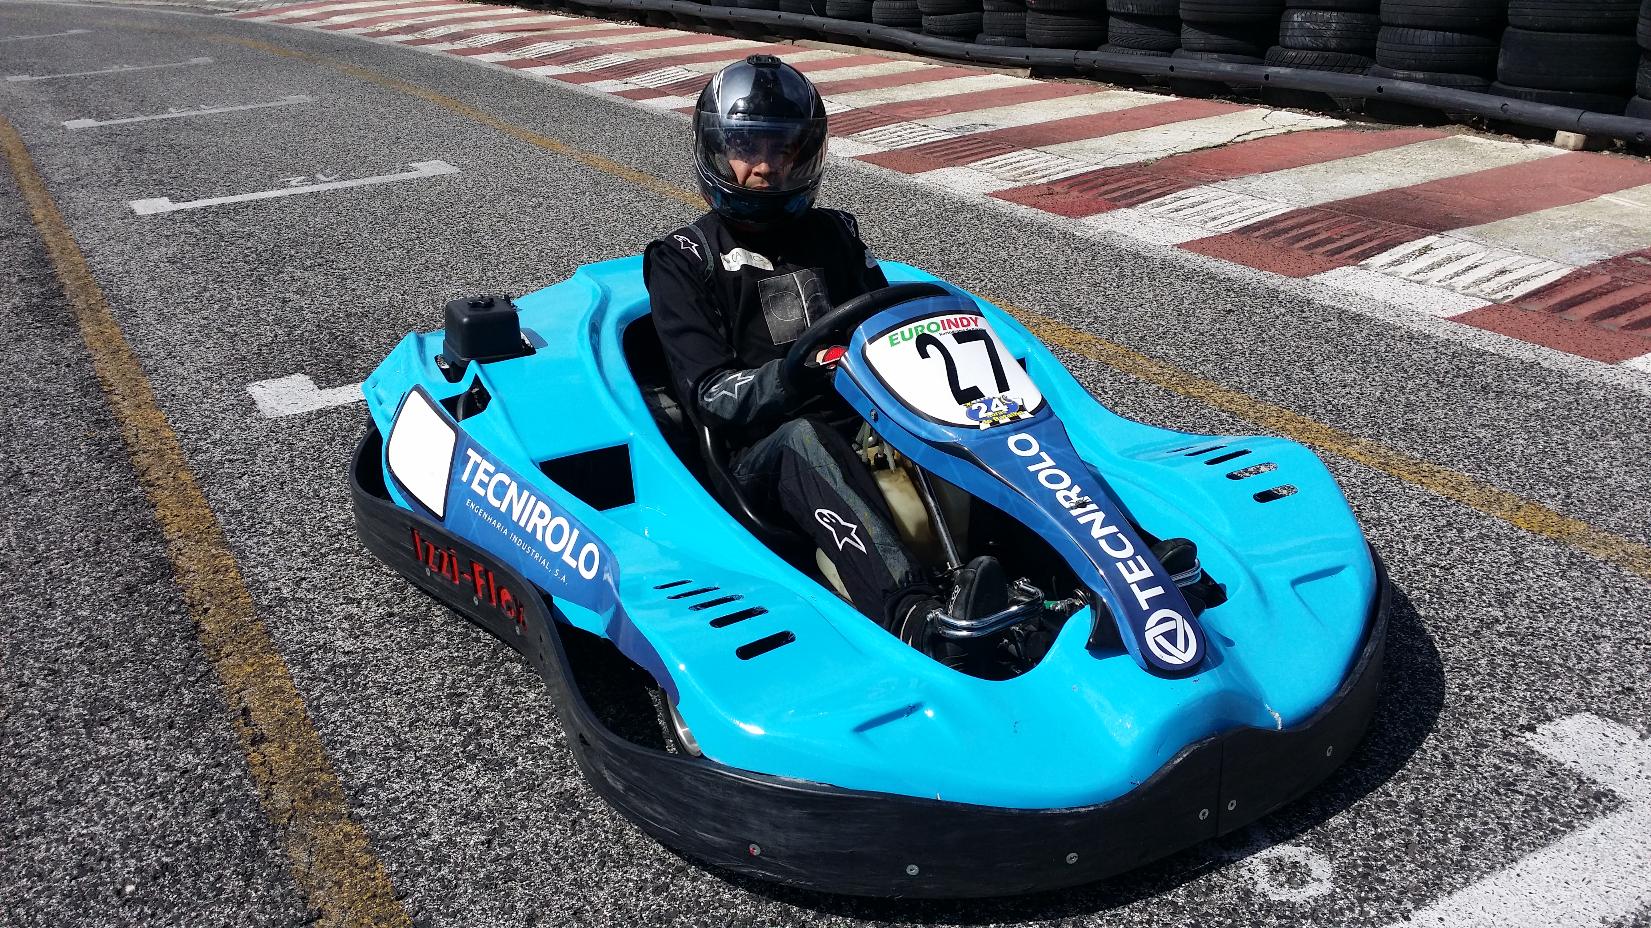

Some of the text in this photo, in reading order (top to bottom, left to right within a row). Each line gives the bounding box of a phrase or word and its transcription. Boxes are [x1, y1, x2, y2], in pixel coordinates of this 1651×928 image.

[888, 316, 979, 347] EUROINDY
[915, 328, 1010, 405] 27
[971, 398, 1009, 418] 24
[460, 448, 600, 580] TECNIROLO
[465, 499, 508, 535] ENGENHARIA
[509, 533, 552, 573] INDUSTRIAL,
[1007, 432, 1166, 611] TECNIROLO
